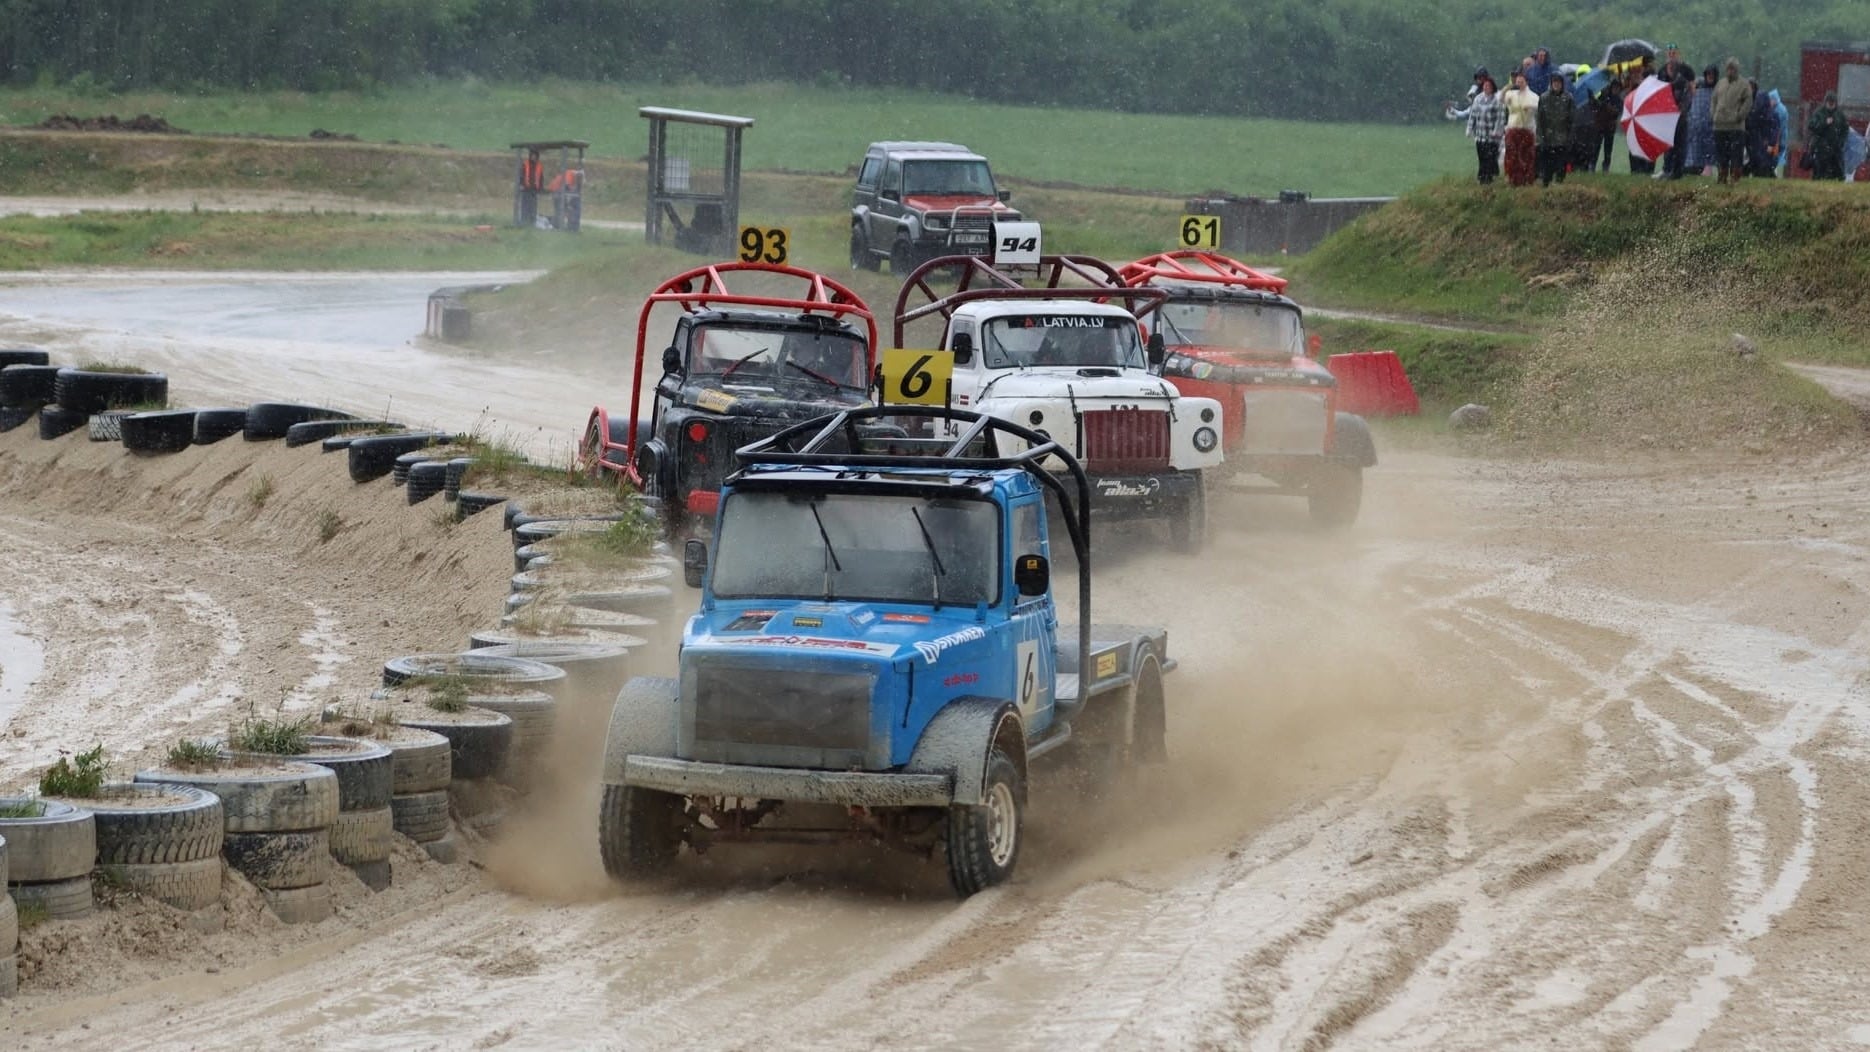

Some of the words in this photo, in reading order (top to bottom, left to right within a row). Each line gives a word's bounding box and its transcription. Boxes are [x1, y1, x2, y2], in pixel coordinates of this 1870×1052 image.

[741, 228, 786, 264] 93
[1000, 238, 1037, 252] 94
[1183, 217, 1217, 246] 61
[900, 355, 933, 398] 6
[1022, 652, 1034, 704] 6
